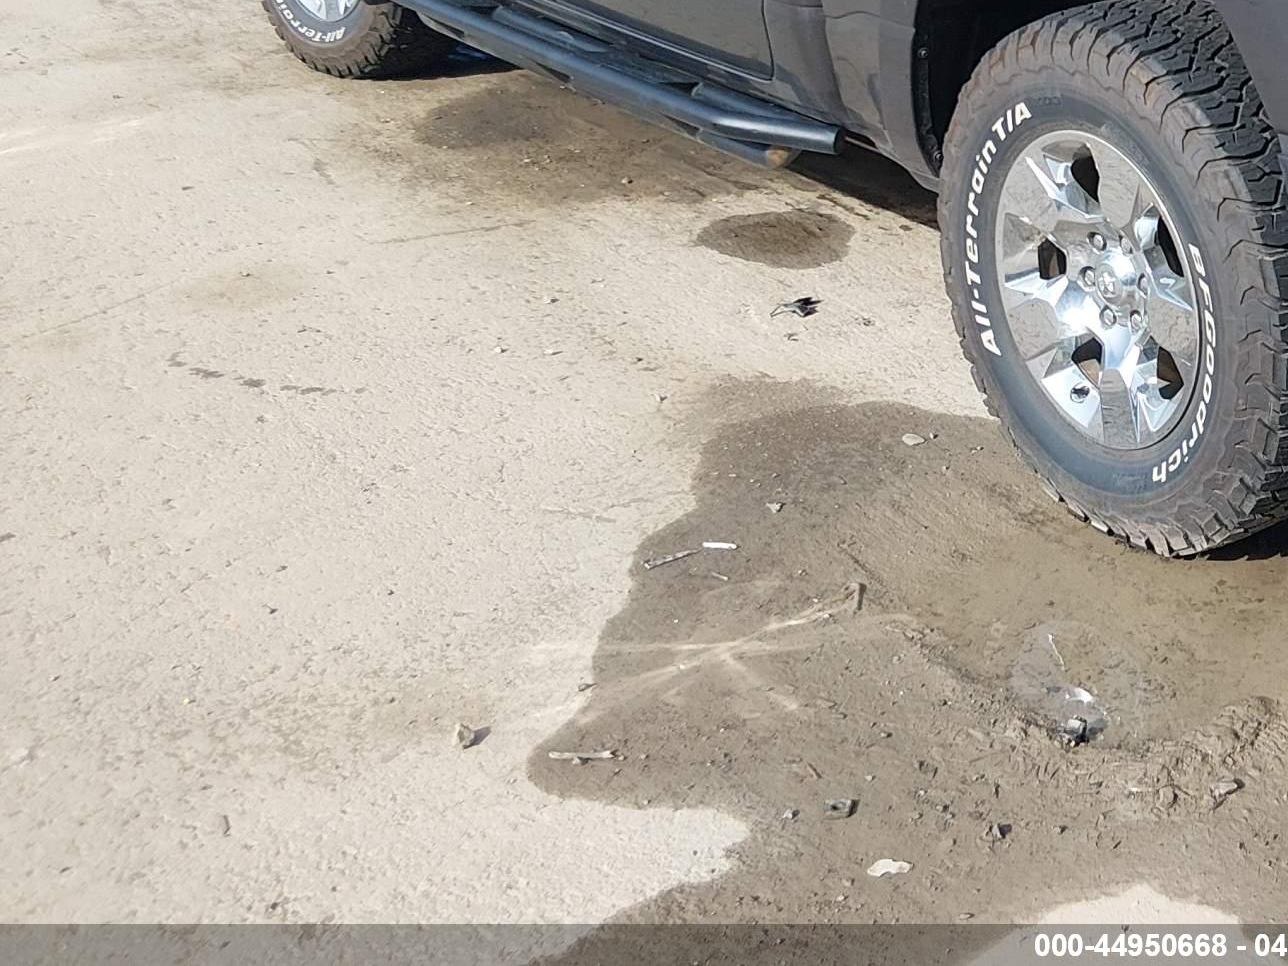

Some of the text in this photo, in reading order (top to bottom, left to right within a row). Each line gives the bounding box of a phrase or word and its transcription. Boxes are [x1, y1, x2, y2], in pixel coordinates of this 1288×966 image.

[965, 101, 1032, 356] All-Terrain T/A
[1152, 243, 1217, 483] BFGoodrich
